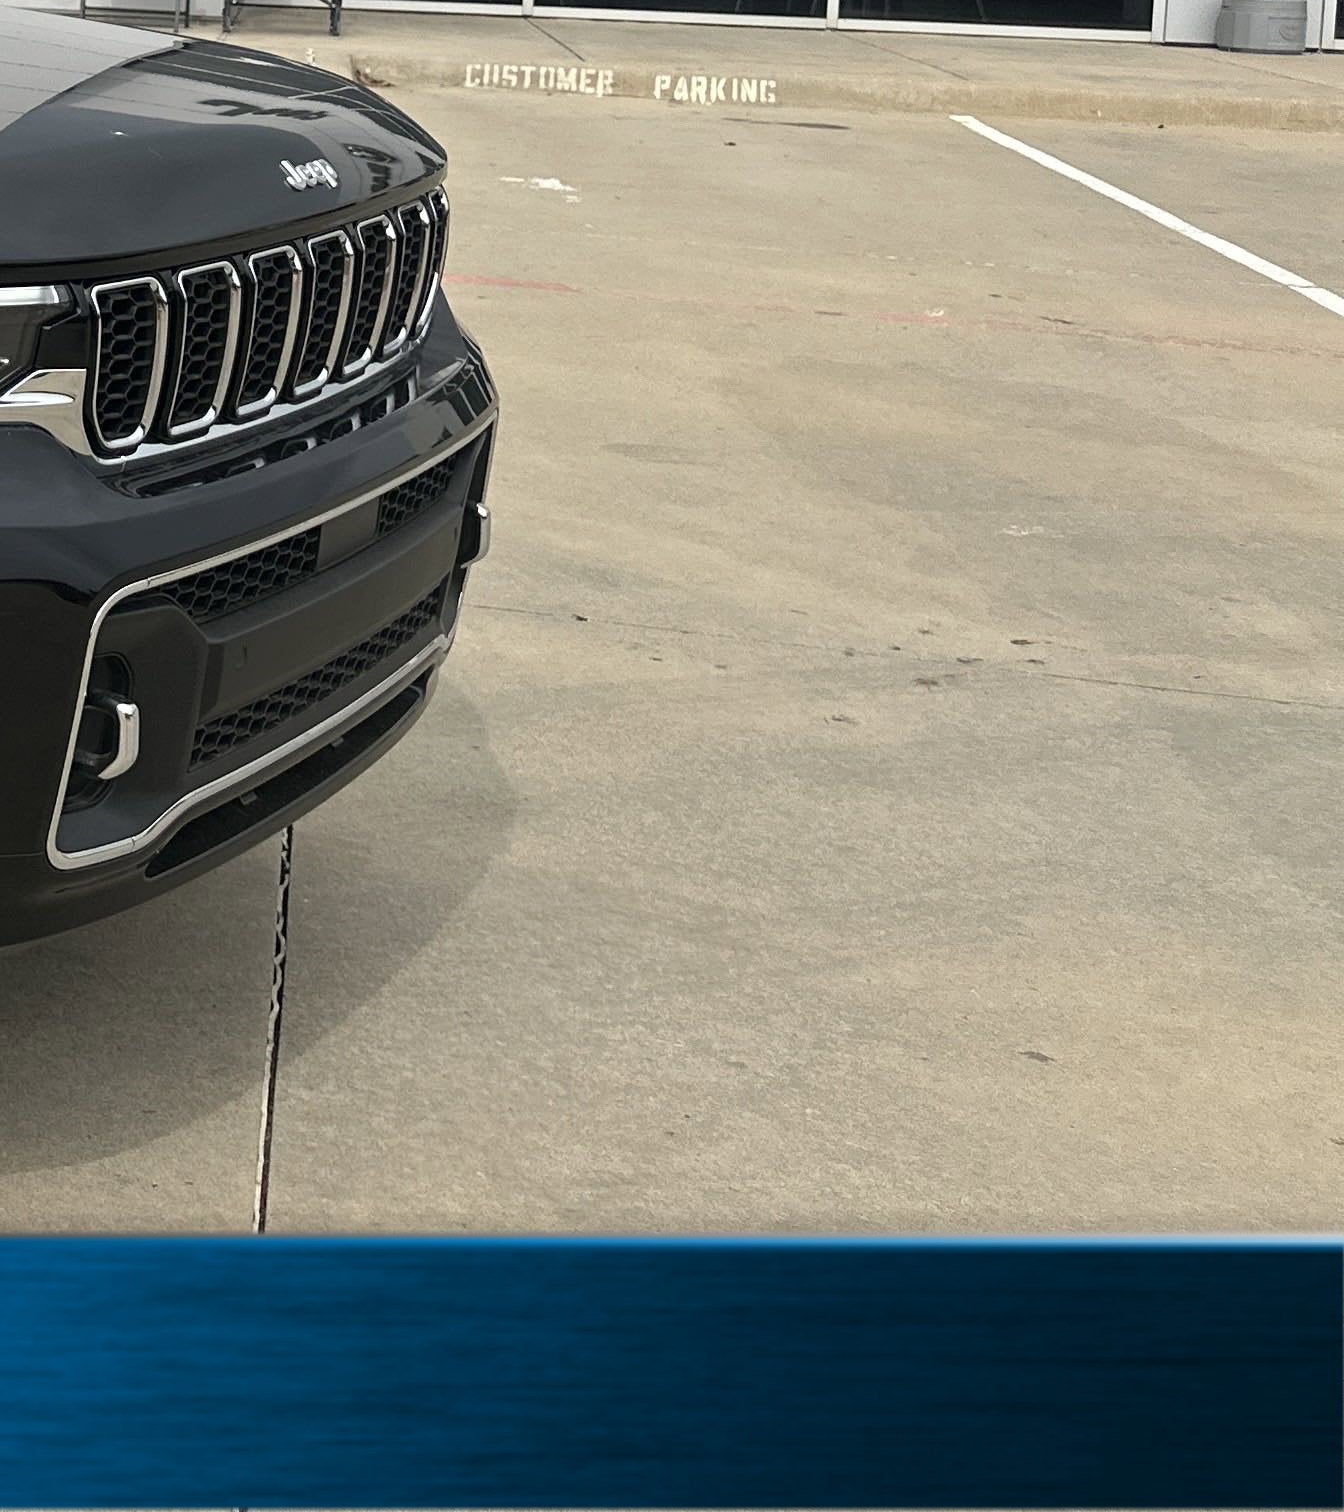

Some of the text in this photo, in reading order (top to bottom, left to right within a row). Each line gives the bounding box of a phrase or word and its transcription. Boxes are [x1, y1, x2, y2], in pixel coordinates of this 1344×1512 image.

[464, 64, 777, 105] CUSTOMER PARKING
[279, 159, 338, 191] Jeep
